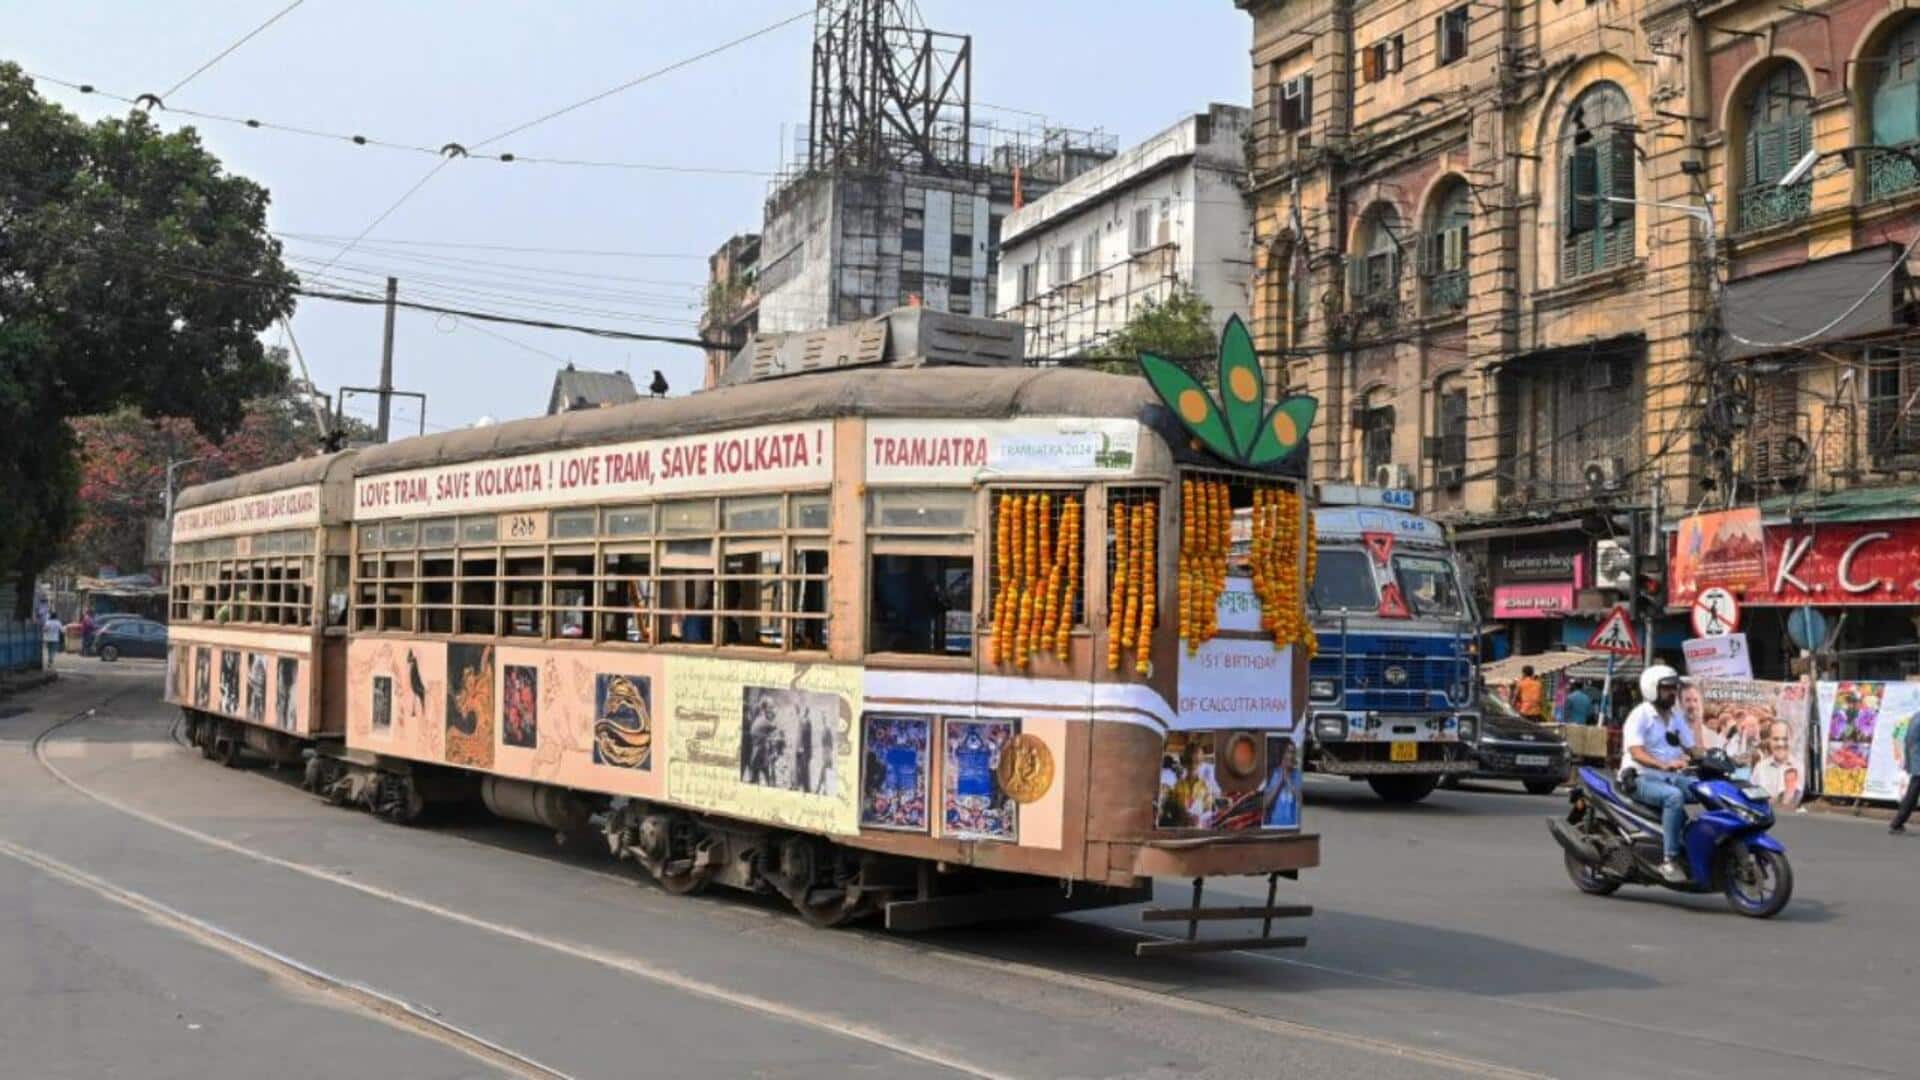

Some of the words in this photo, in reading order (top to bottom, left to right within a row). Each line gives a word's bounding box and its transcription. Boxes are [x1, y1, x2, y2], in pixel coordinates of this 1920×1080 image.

[874, 437, 988, 467] TRAMJATRA
[360, 482, 390, 507] LOVE
[394, 477, 431, 506] TRAM,
[436, 472, 470, 500] SAVE
[475, 464, 542, 496] KOLKATA
[560, 456, 600, 488] LOVE
[604, 450, 655, 485] TRAM,
[660, 443, 707, 479] SAVE
[713, 433, 808, 474] KOLKATA
[1383, 490, 1411, 506] GAS
[1401, 519, 1425, 530] GAS
[1223, 654, 1277, 669] BIRTHDAY
[1180, 696, 1197, 712] OF
[1199, 696, 1258, 713] CALCUTTA
